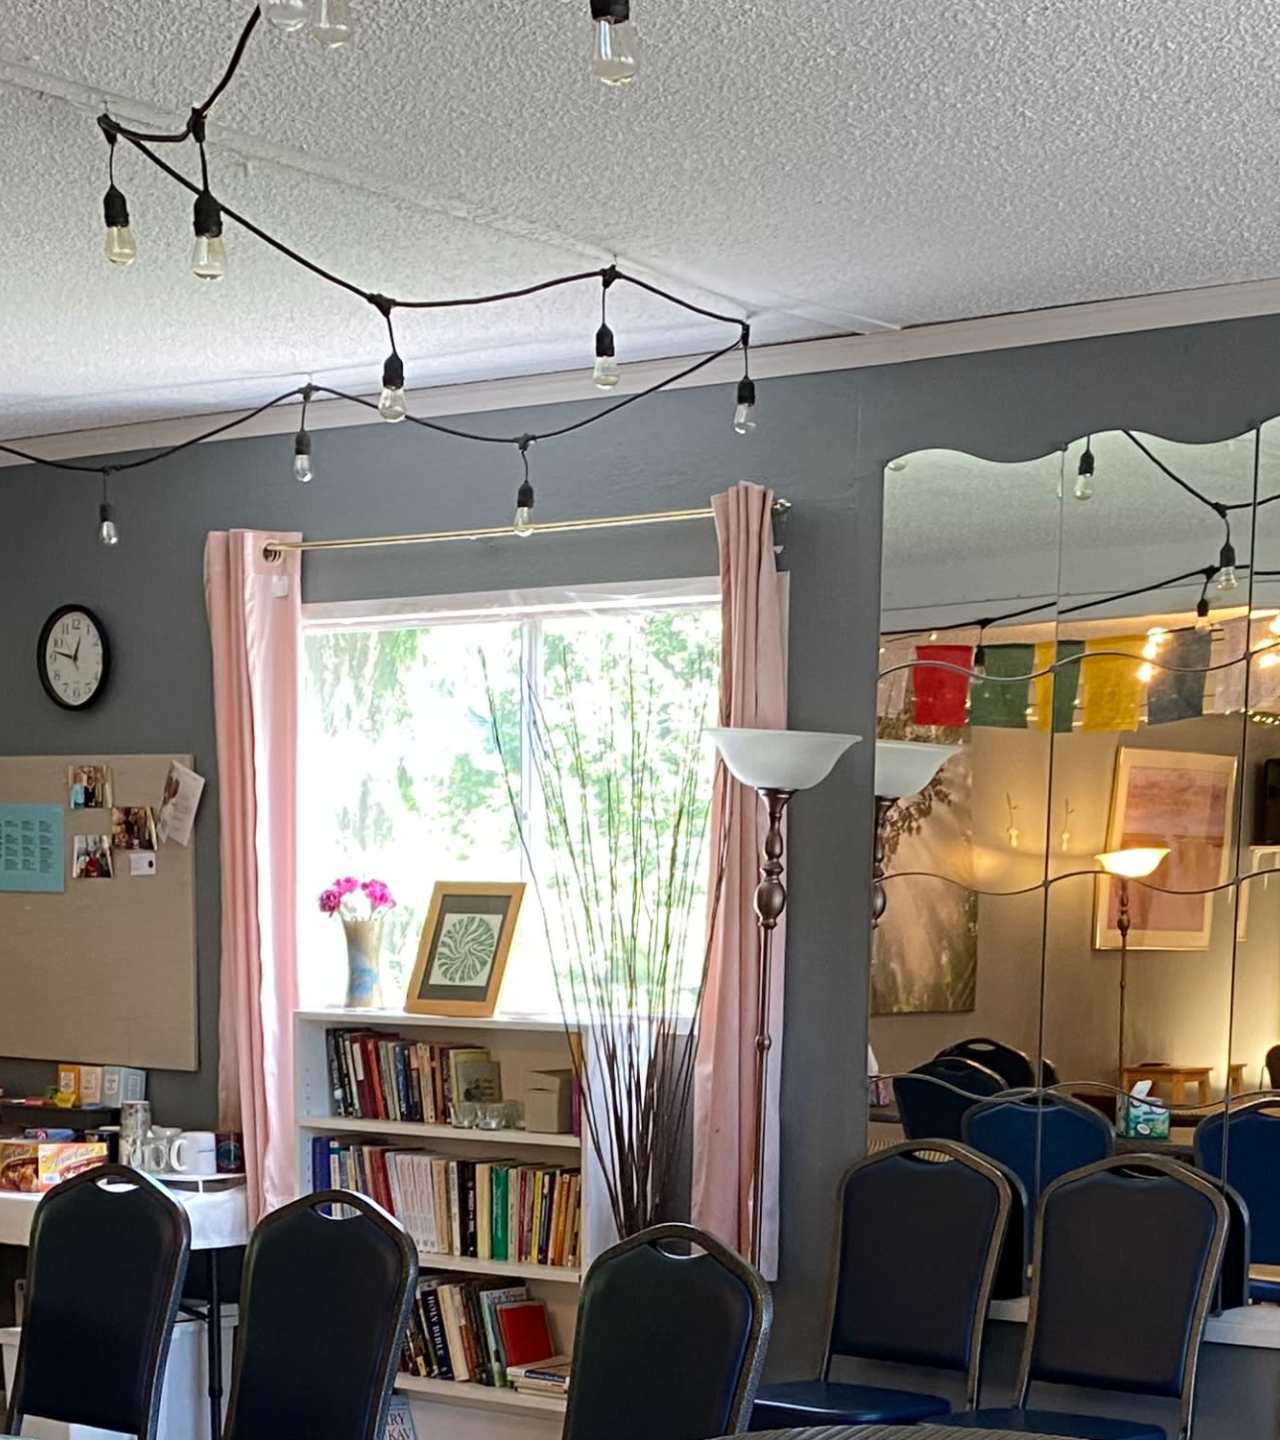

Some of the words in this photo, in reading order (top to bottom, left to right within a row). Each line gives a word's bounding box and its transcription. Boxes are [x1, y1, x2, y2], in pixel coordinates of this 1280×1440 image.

[62, 623, 70, 635] 11
[427, 1296, 440, 1323] HOLY
[432, 1325, 445, 1356] BIBLE
[385, 1427, 412, 1440] KAV
